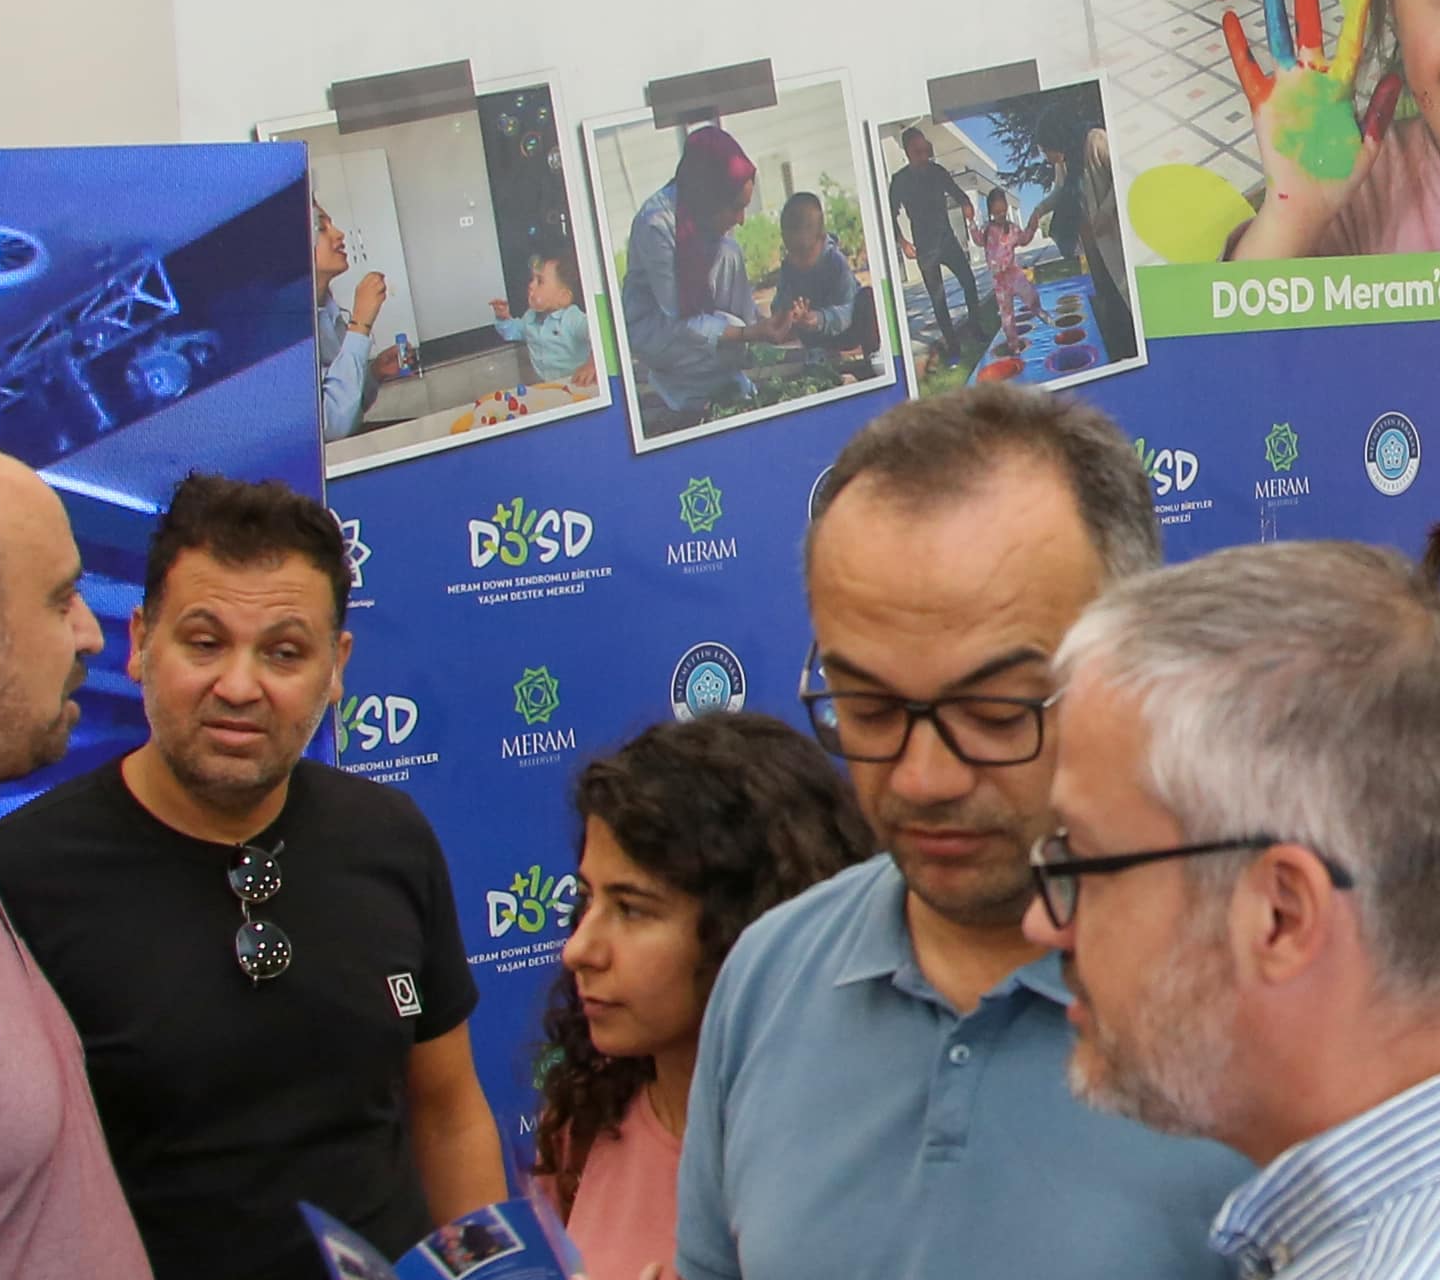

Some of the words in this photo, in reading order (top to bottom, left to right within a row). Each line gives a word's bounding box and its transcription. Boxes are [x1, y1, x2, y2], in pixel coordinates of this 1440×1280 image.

[1212, 275, 1315, 319] DOSD
[1254, 477, 1311, 500] MERAM
[666, 537, 738, 566] MERAM
[447, 583, 481, 595] MERAM
[482, 579, 513, 591] DOWN
[514, 573, 570, 588] SENDROMLU
[571, 567, 613, 581] BİREYLER
[477, 593, 509, 606] YAŞAM
[510, 589, 544, 602] DESTEK
[546, 580, 585, 596] MERKEZİ
[501, 727, 576, 760] MERAM
[340, 759, 394, 774] ENDROMLU
[394, 752, 440, 768] BİREYLER
[501, 945, 531, 960] DOWN
[496, 960, 527, 973] YAŞAM
